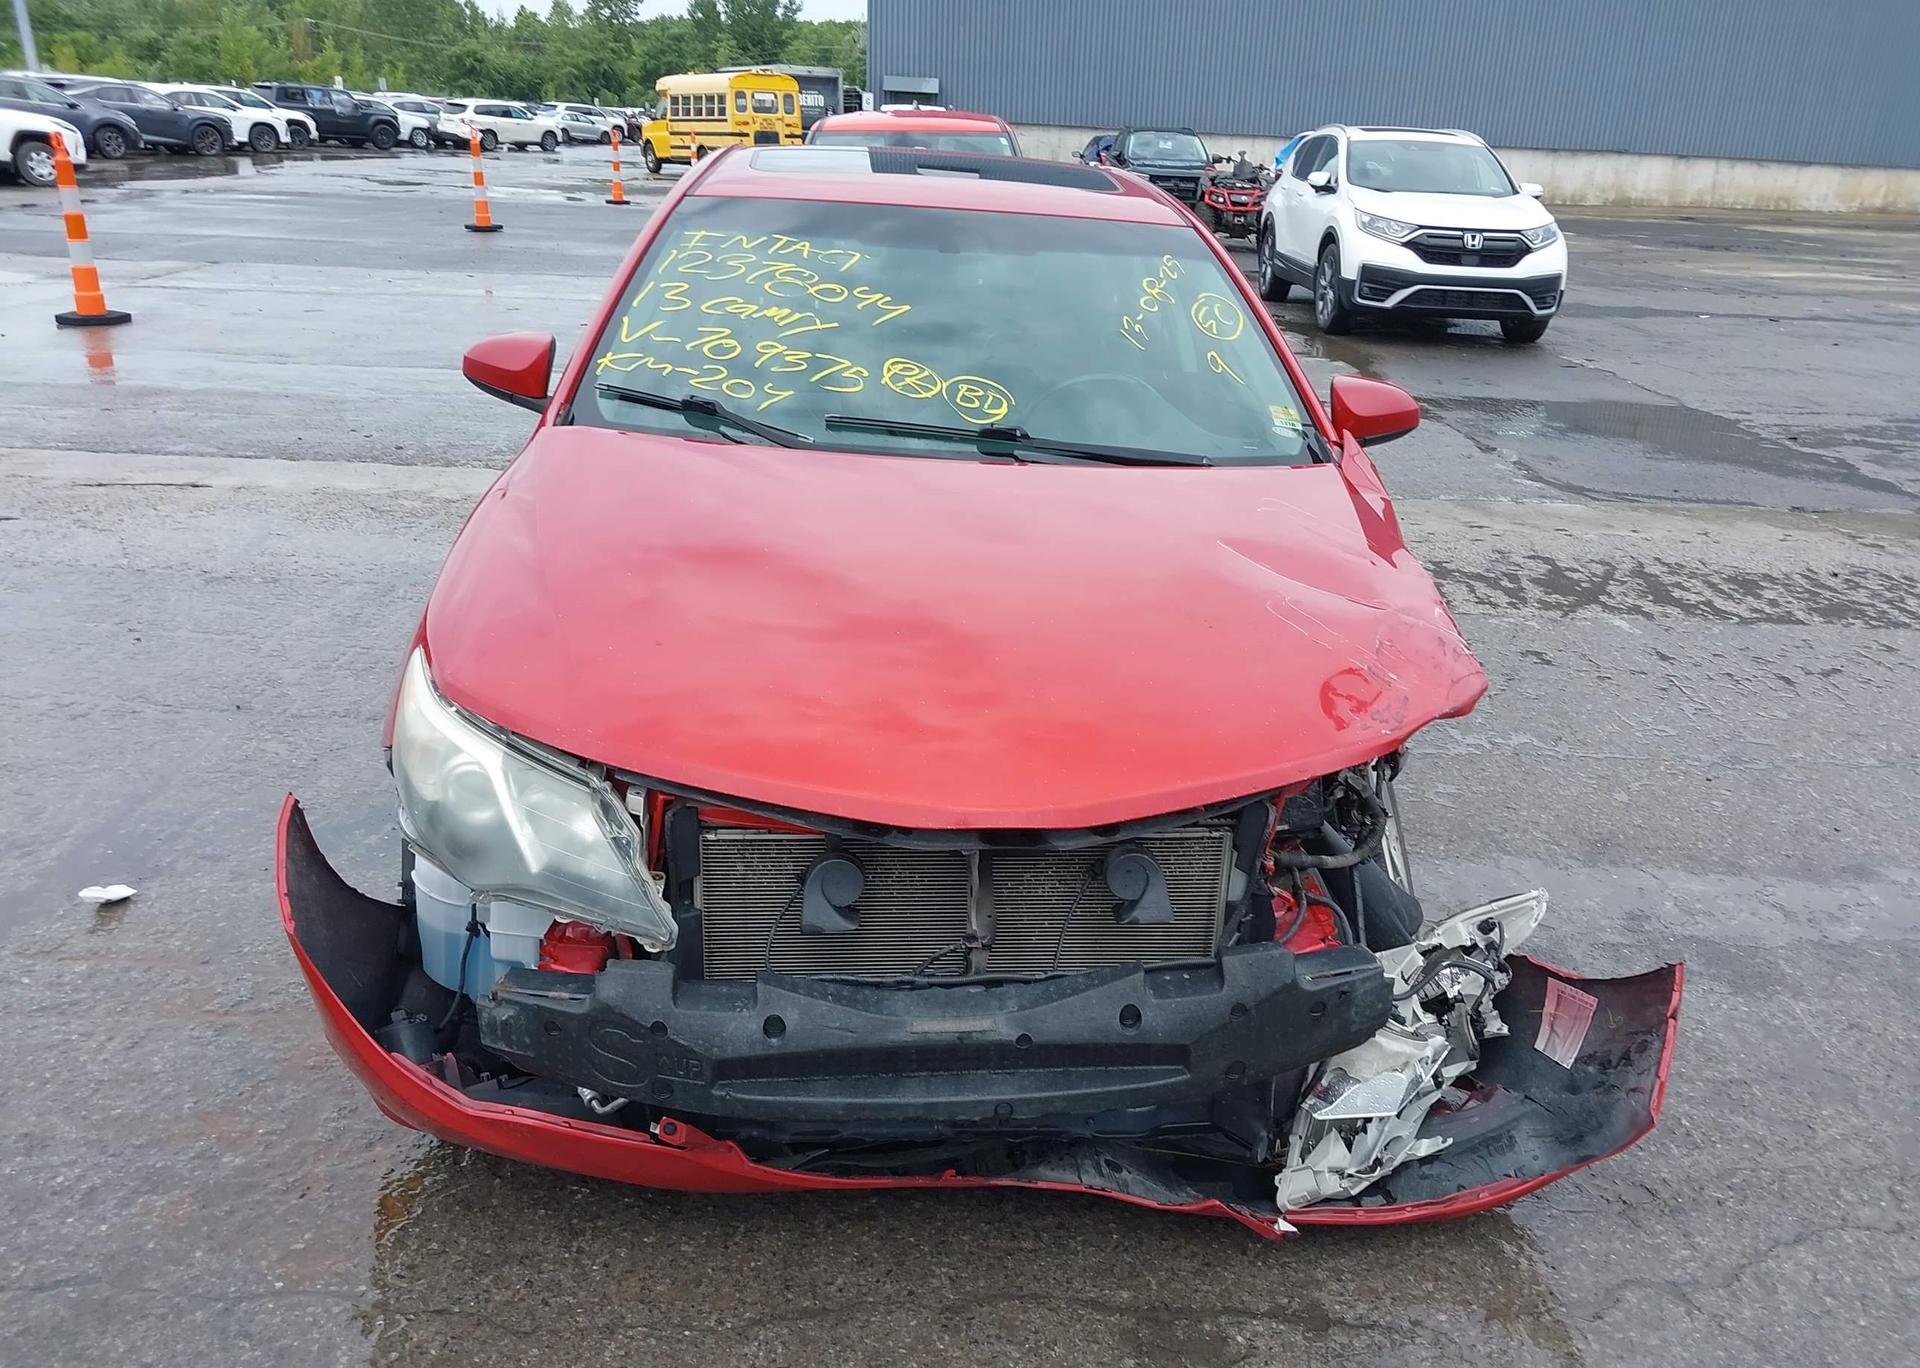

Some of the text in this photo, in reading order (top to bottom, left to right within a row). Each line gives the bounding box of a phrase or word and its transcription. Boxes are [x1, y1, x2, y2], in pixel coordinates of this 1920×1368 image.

[680, 230, 871, 272] INTACT
[631, 281, 692, 312] 13
[1207, 351, 1246, 385] 9
[674, 1057, 702, 1080] UP
